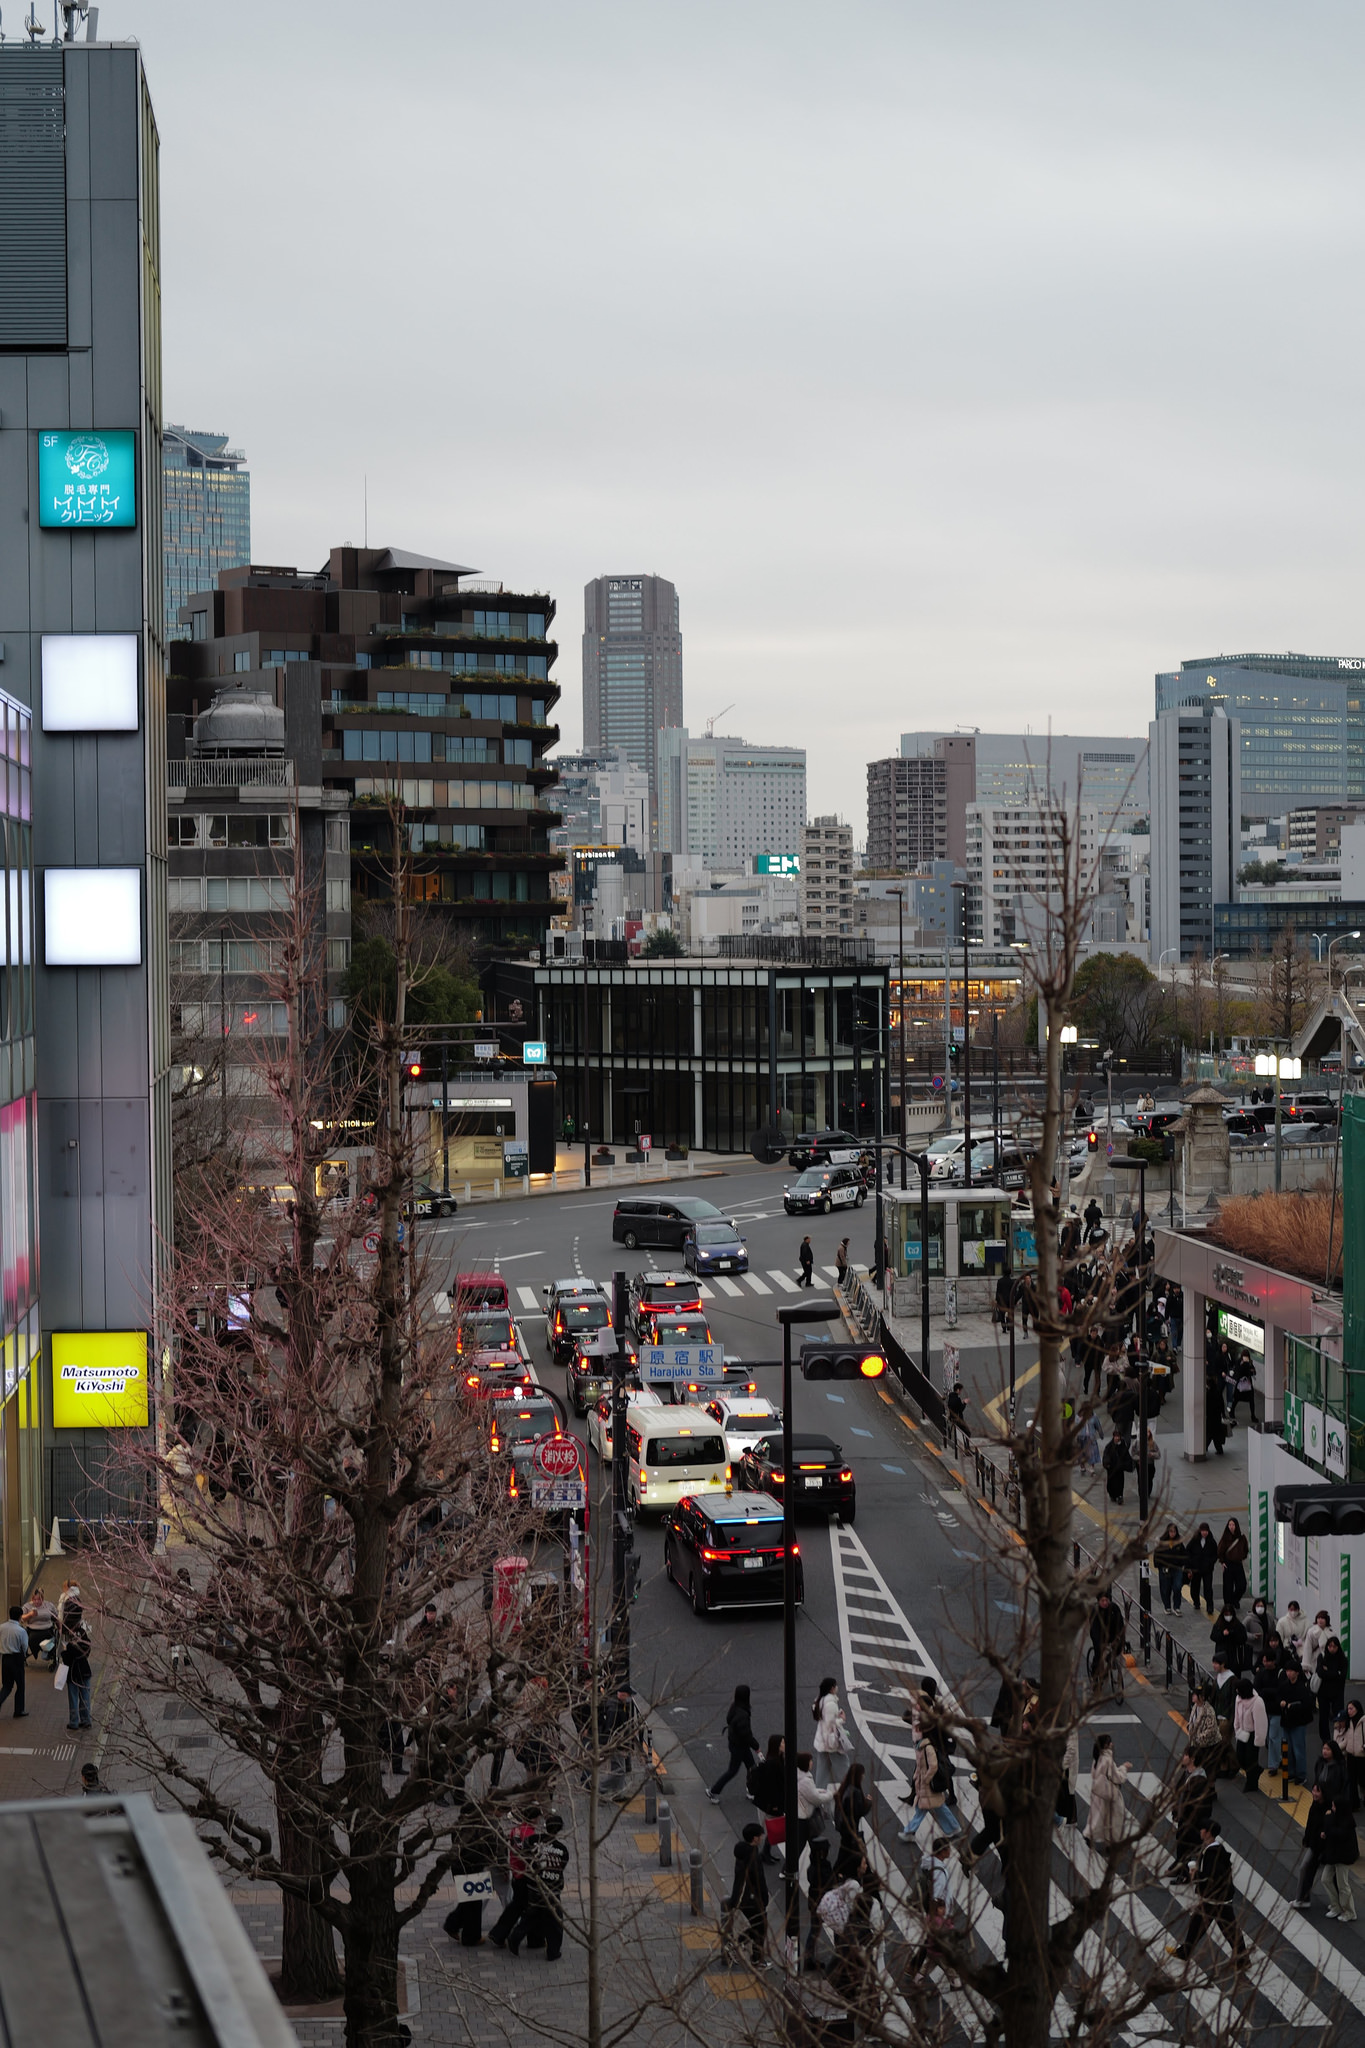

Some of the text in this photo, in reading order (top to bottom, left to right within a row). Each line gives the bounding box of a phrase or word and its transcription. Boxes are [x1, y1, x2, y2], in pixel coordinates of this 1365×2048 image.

[43, 436, 58, 447] 5F
[64, 484, 110, 495] 脱毛専門
[61, 509, 114, 523] クリニック
[1338, 659, 1362, 669] PARCO
[326, 1120, 361, 1129] JUCTION
[1219, 1313, 1228, 1330] JR
[649, 1350, 715, 1365] 原宿駅
[61, 1366, 139, 1379] Matsumoto
[649, 1365, 716, 1378] Harajuku Sta.
[75, 1380, 125, 1393] KiYoshi
[544, 1449, 576, 1465] 消火栓
